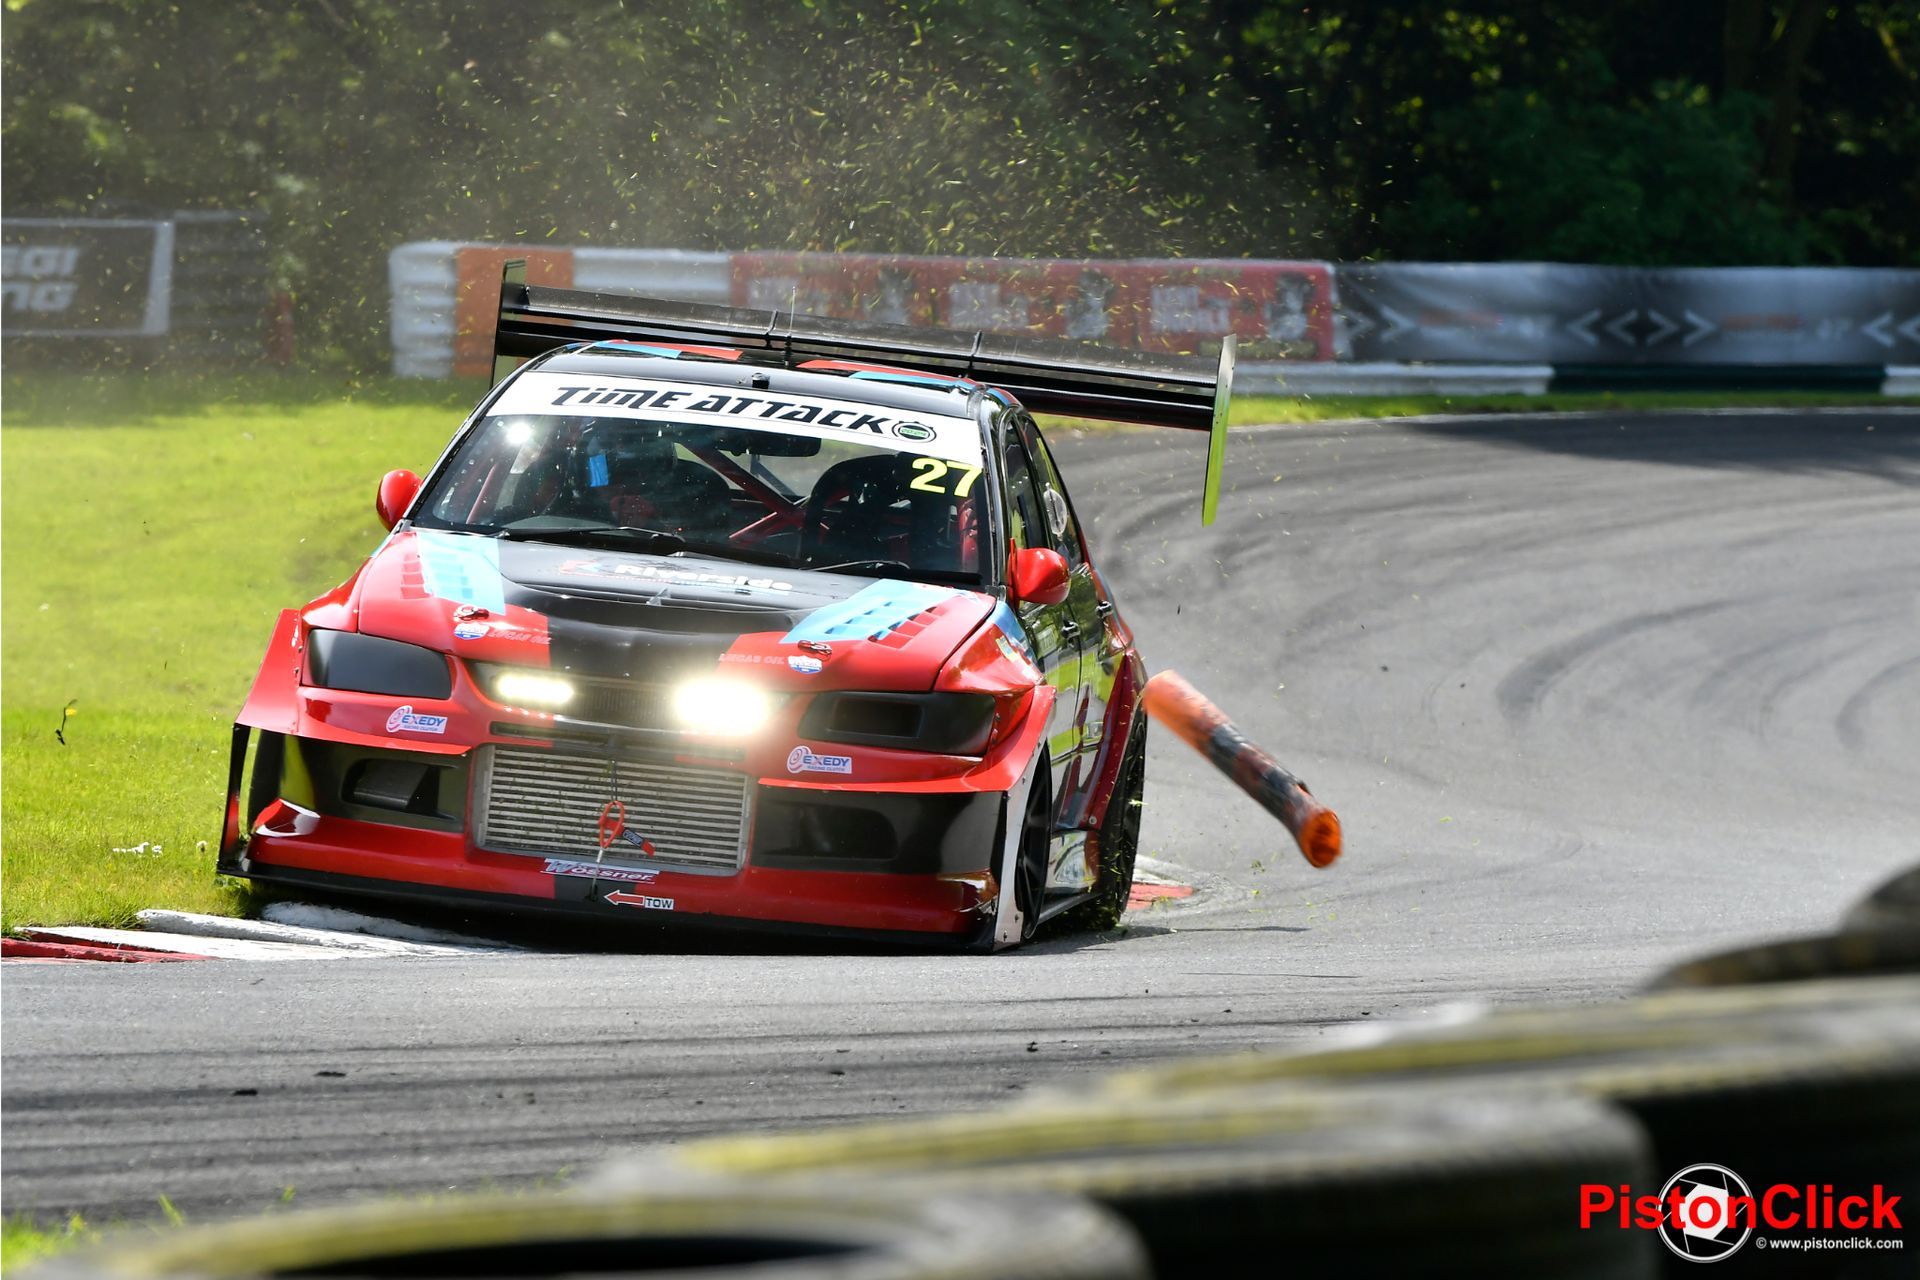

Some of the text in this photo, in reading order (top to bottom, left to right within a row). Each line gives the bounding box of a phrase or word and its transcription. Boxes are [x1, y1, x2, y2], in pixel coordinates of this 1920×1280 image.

[694, 394, 894, 434] ATTACK
[910, 457, 982, 497] 27
[401, 714, 445, 727] EXEDY
[803, 755, 850, 767] EXEDY
[646, 898, 673, 909] TOW
